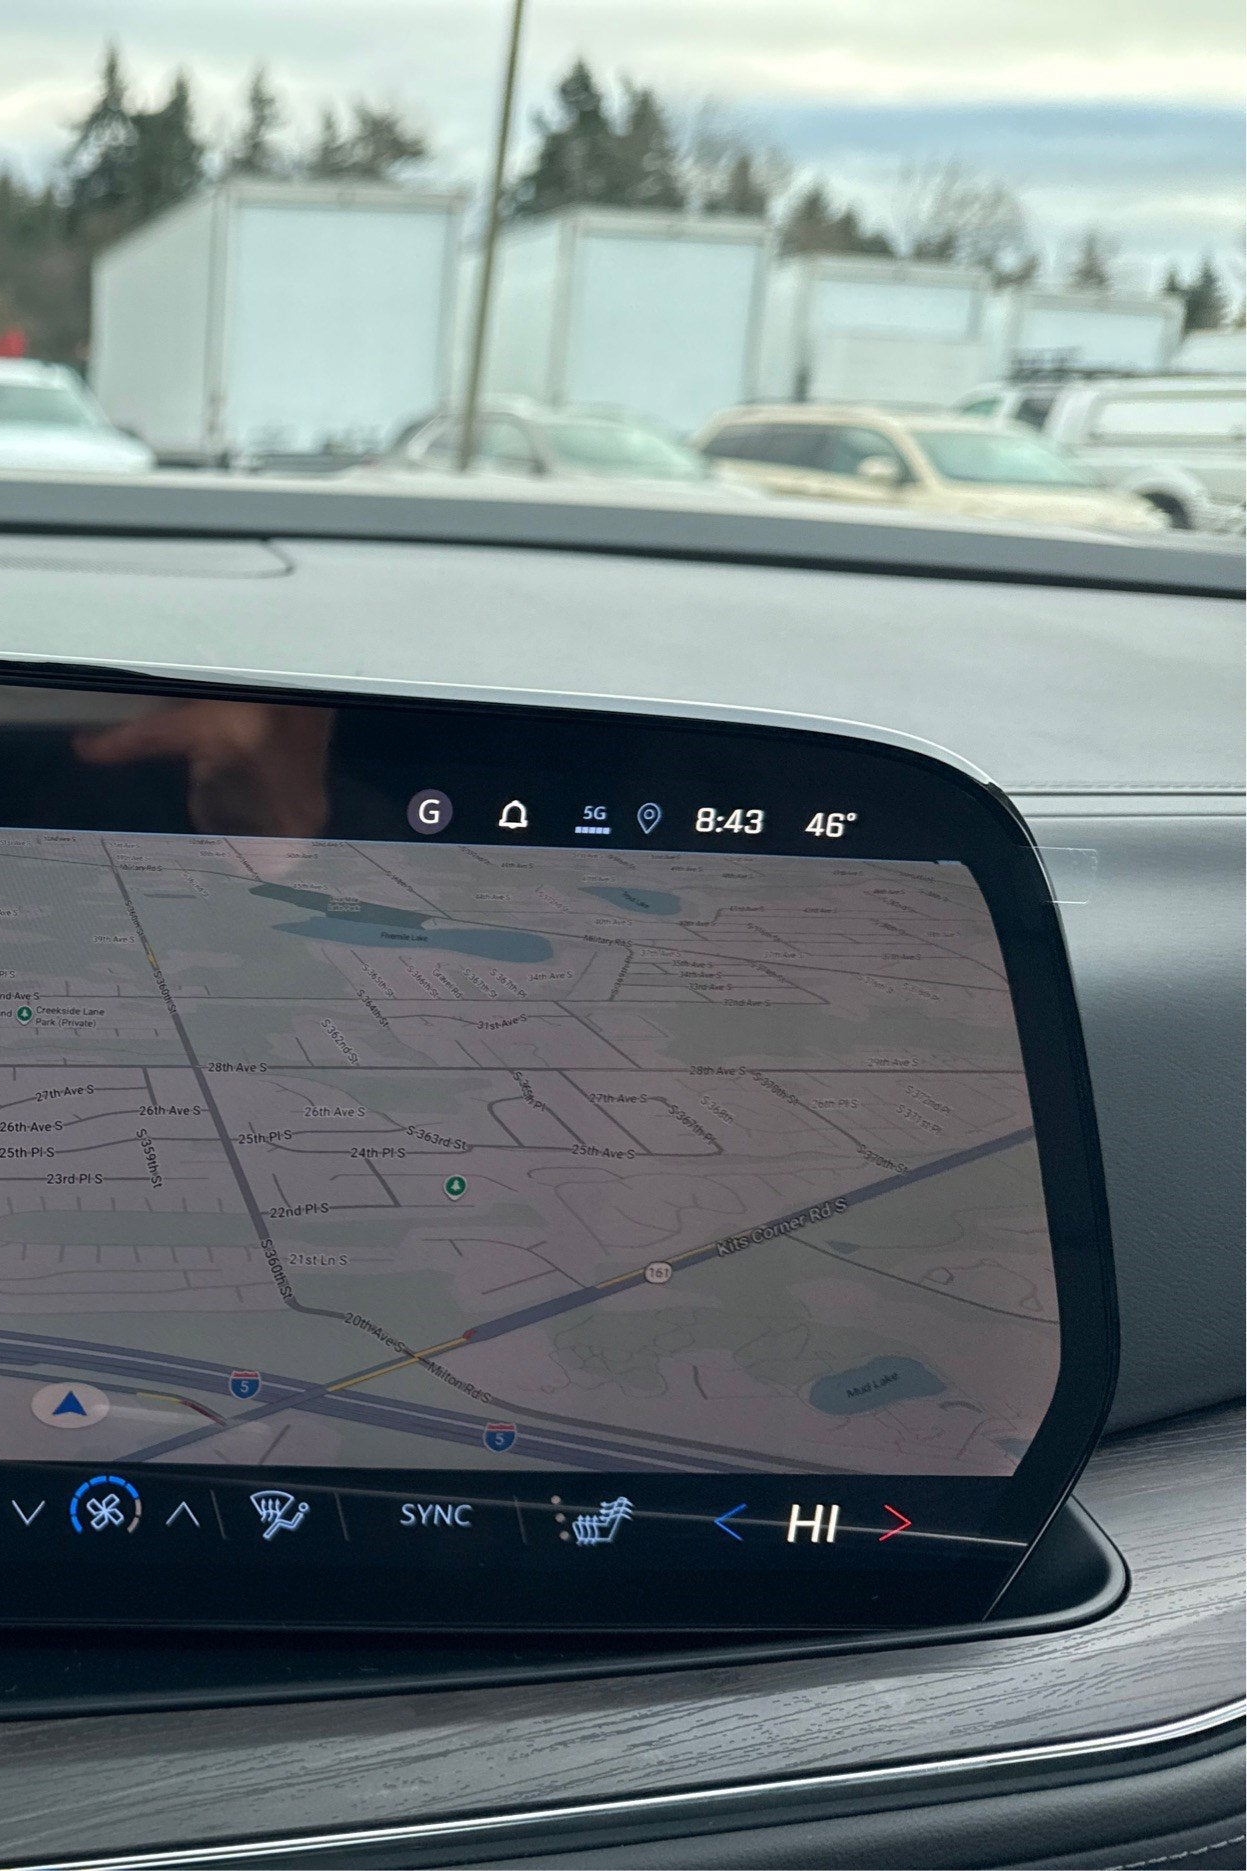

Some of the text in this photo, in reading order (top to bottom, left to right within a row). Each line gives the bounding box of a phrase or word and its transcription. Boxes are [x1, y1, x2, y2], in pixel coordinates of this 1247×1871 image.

[418, 799, 440, 824] G
[583, 805, 607, 821] 5G
[695, 808, 764, 835] 8:43
[805, 811, 858, 837] 46°
[9, 970, 15, 978] S
[13, 992, 30, 1000] Ave
[33, 992, 39, 1000] S
[36, 1006, 105, 1016] Creekside Lane
[36, 1018, 96, 1028] Park (Private)
[477, 1014, 527, 1029] 31st Ave S
[208, 1063, 268, 1073] 28th Ave S
[689, 1066, 746, 1076] 28th Ave S
[35, 1085, 94, 1102] 27th Ave S
[590, 1094, 647, 1104] 27th Ave S
[139, 1106, 201, 1116] 26th Ave S
[305, 1107, 365, 1117] 26th Ave S
[0, 1121, 63, 1132] 26th Ave S
[239, 1130, 292, 1143] 25th Pl S
[407, 1126, 466, 1150] S 363rd St
[0, 1148, 54, 1158] 25th Pl S
[351, 1148, 406, 1158] 24th Pl S
[572, 1144, 635, 1158] 25th Ave S
[137, 1129, 162, 1188] S 359th St
[47, 1174, 102, 1184] 23rd Pl S
[271, 1203, 329, 1218] 22nd Pl S
[717, 1198, 848, 1257] Kits Corner Rd S
[289, 1254, 348, 1265] 21st Ln S
[261, 1238, 293, 1298] S 360th St
[650, 1268, 669, 1278] 161
[345, 1312, 406, 1353] 20th Ave S
[241, 1381, 249, 1392] 5
[428, 1361, 491, 1403] Milton Rd S
[873, 1373, 899, 1390] Lake
[496, 1434, 504, 1444] 5
[400, 1503, 473, 1527] SYNC
[787, 1504, 839, 1543] HI
